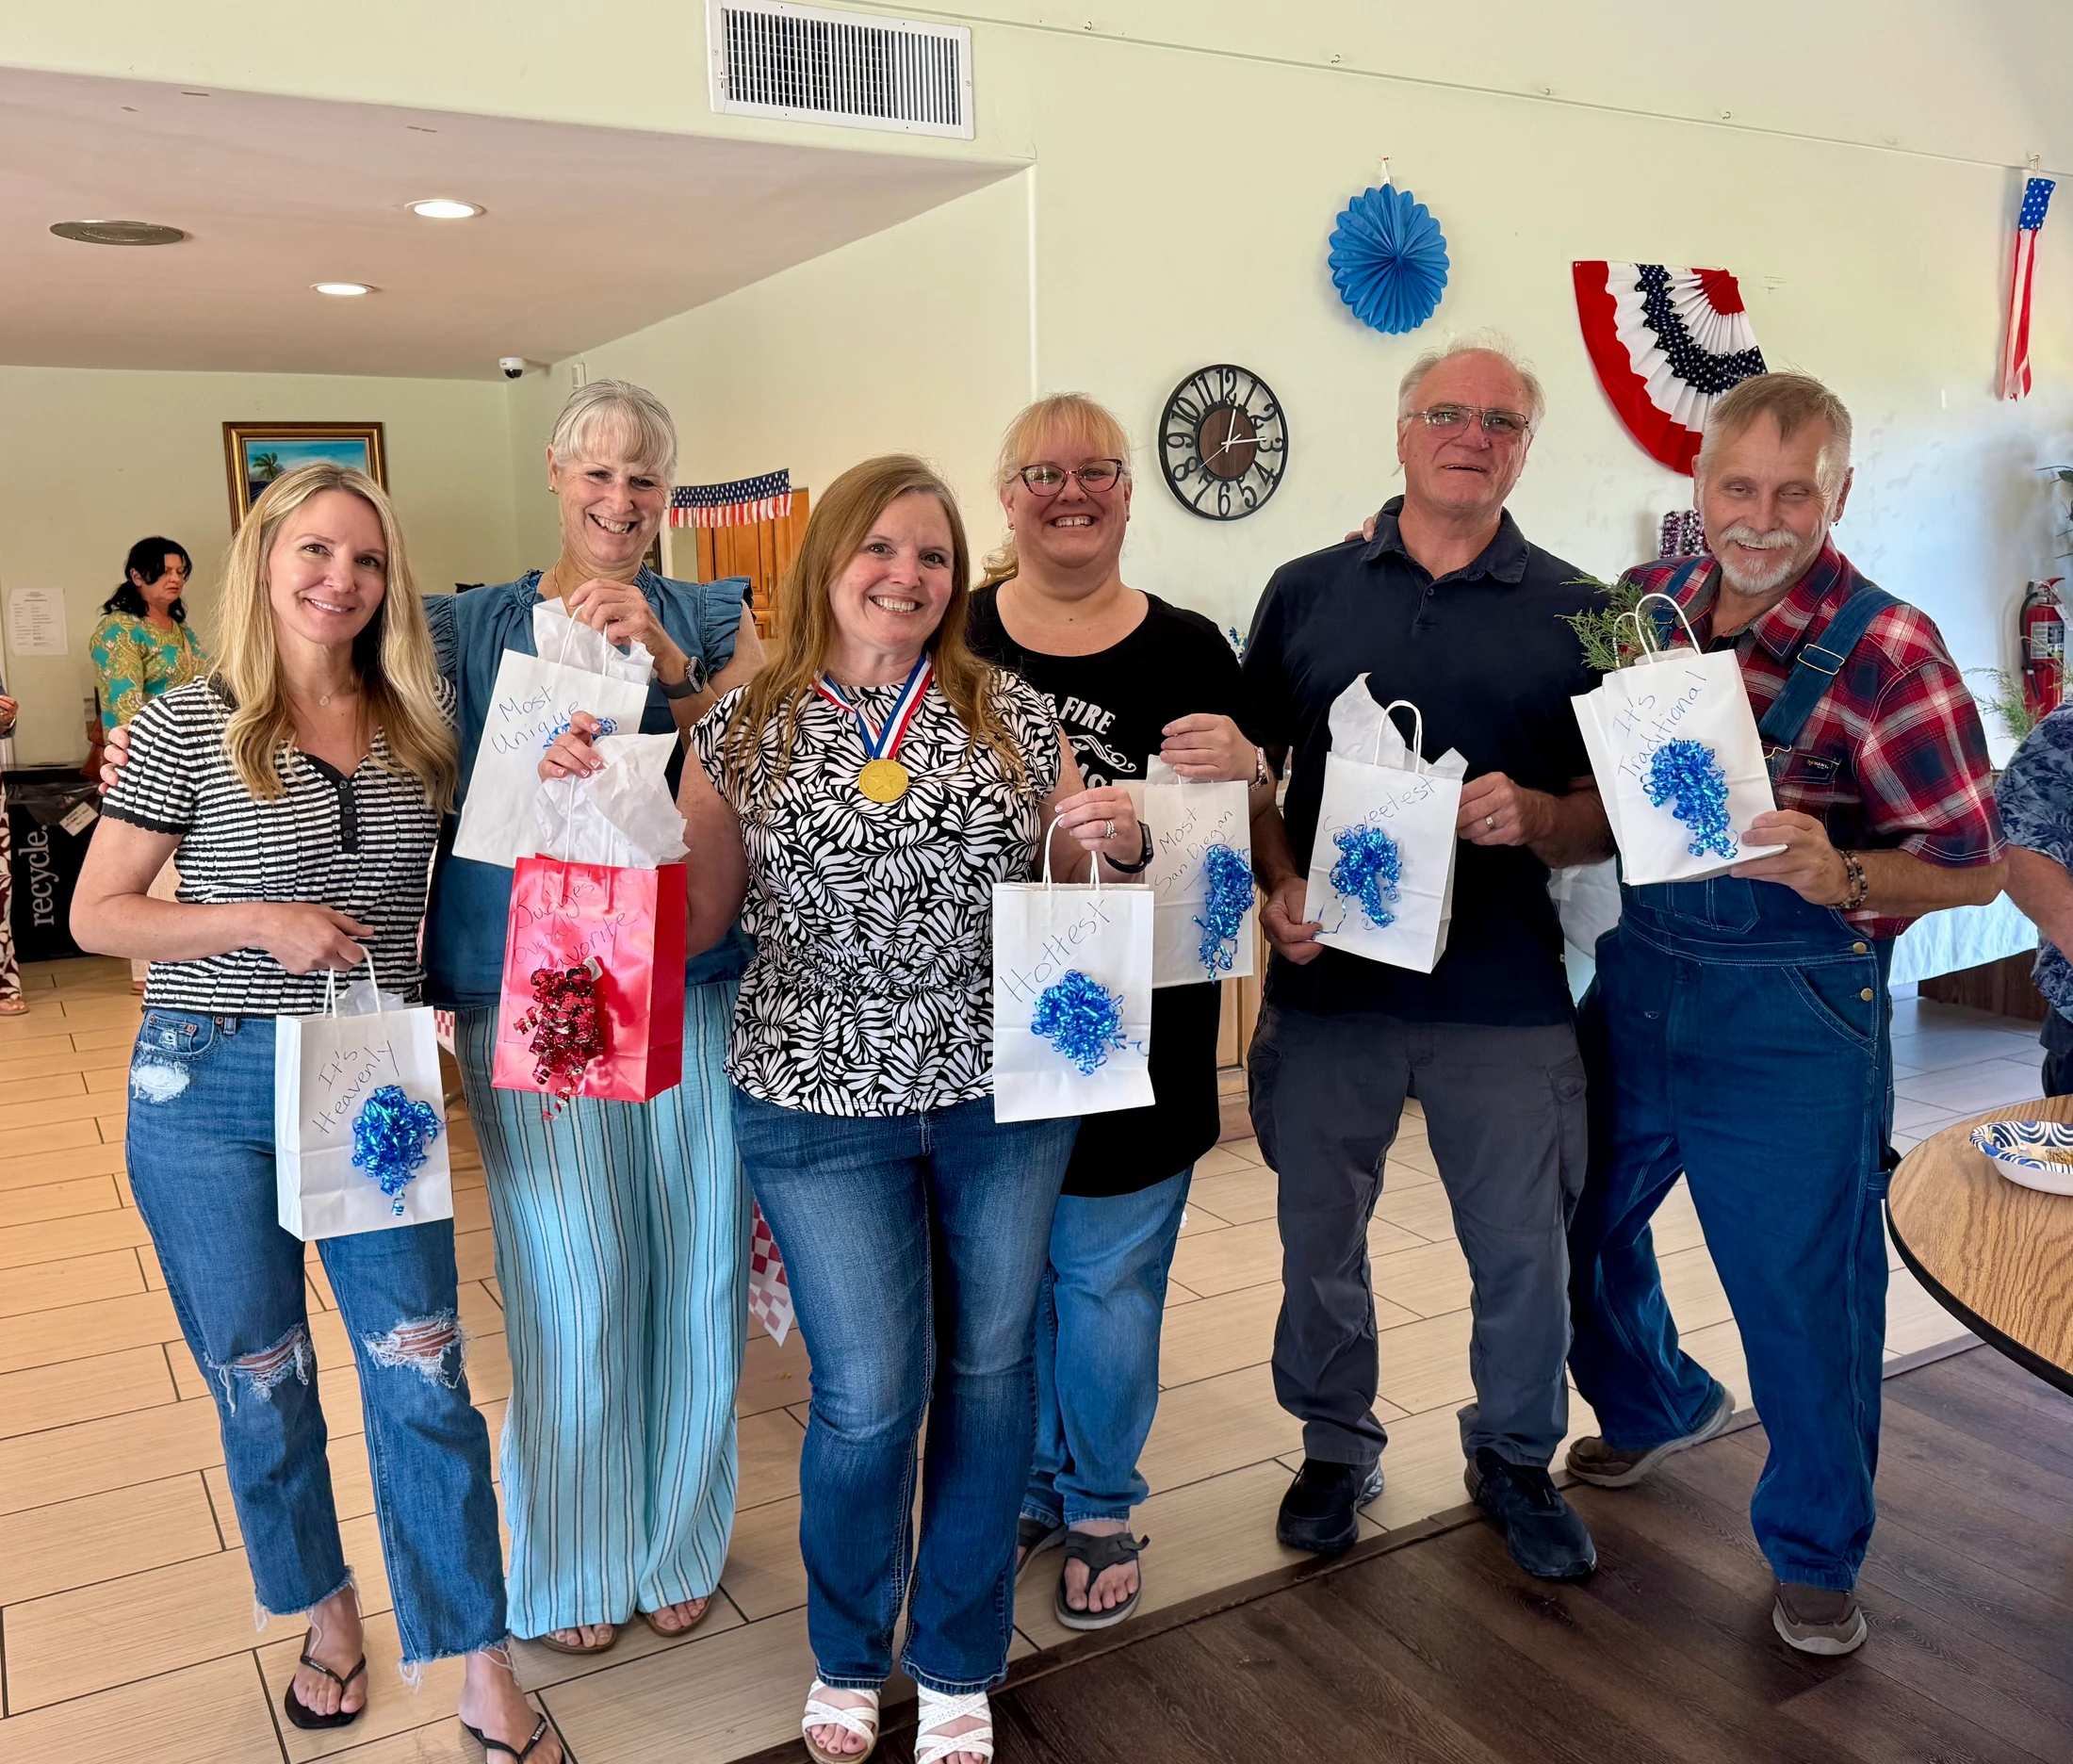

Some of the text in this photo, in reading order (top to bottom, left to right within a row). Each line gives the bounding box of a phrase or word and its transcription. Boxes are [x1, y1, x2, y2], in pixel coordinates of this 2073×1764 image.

[1190, 372, 1216, 407] 11
[1216, 368, 1237, 405] 12
[1242, 379, 1260, 409] 1
[1170, 397, 1200, 427] 10
[1250, 403, 1278, 430] 2
[1167, 433, 1194, 449] 9
[1258, 436, 1283, 452] 3
[1173, 456, 1199, 482] 8
[1253, 459, 1279, 486] 4
[1194, 471, 1216, 508] 7
[1218, 482, 1231, 517] 6
[1236, 473, 1257, 508] 5
[498, 685, 552, 724] Most
[1058, 696, 1116, 735] FIRE
[1613, 695, 1655, 737] It's
[1618, 670, 1706, 776] Traditional
[1159, 807, 1197, 854] Most
[18, 824, 59, 926] recycle.
[1154, 863, 1187, 896] San
[1000, 899, 1110, 1003] Hottest
[312, 1040, 400, 1135] Heavenly
[318, 1049, 358, 1092] It's
